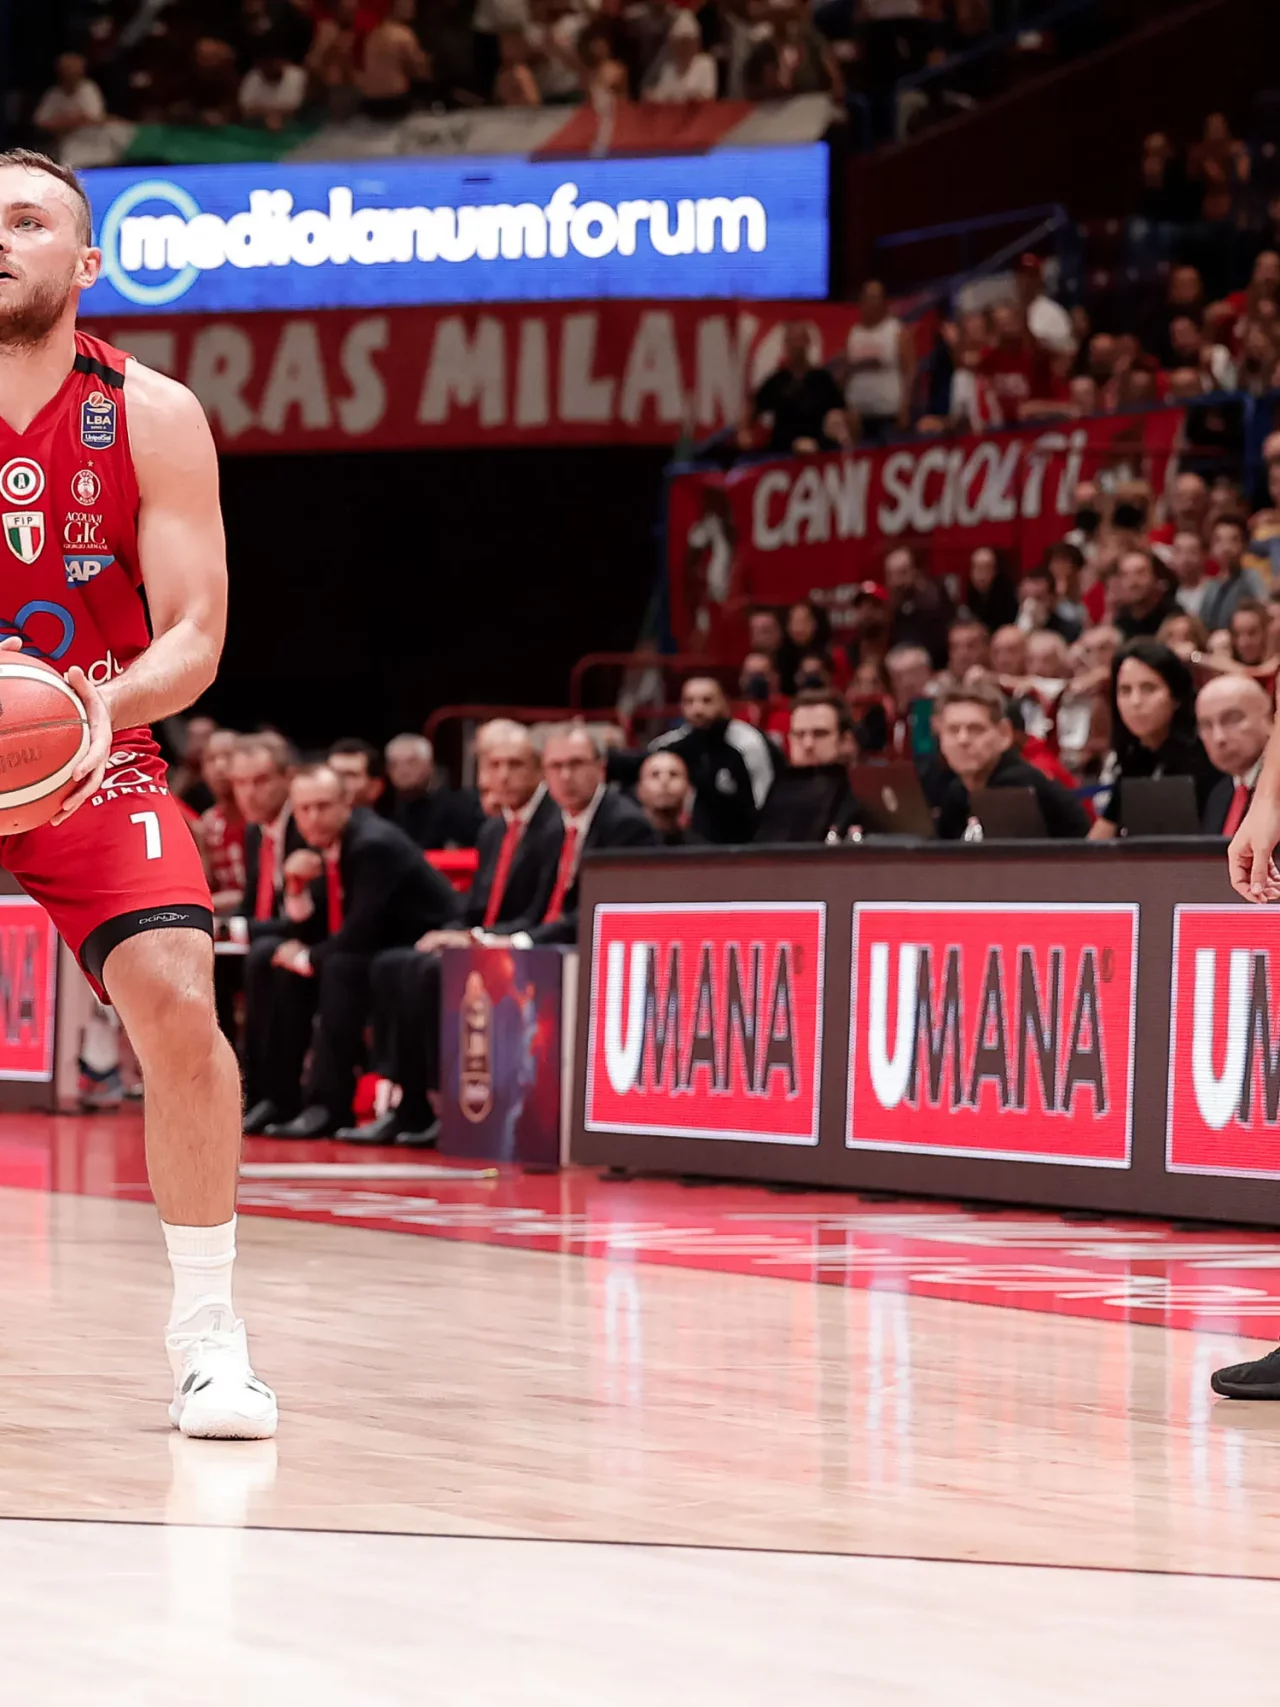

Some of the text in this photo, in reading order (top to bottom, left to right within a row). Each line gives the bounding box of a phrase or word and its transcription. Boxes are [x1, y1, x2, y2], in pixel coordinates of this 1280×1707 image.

[120, 182, 767, 271] mediolanumforum
[86, 415, 112, 425] LBA
[14, 516, 33, 526] FIP
[752, 430, 1088, 551] CANI SCIOLTI
[91, 784, 169, 807] OAKLEY
[129, 811, 162, 860] 1
[603, 940, 799, 1098] UMANA
[867, 941, 1111, 1119] UMANA
